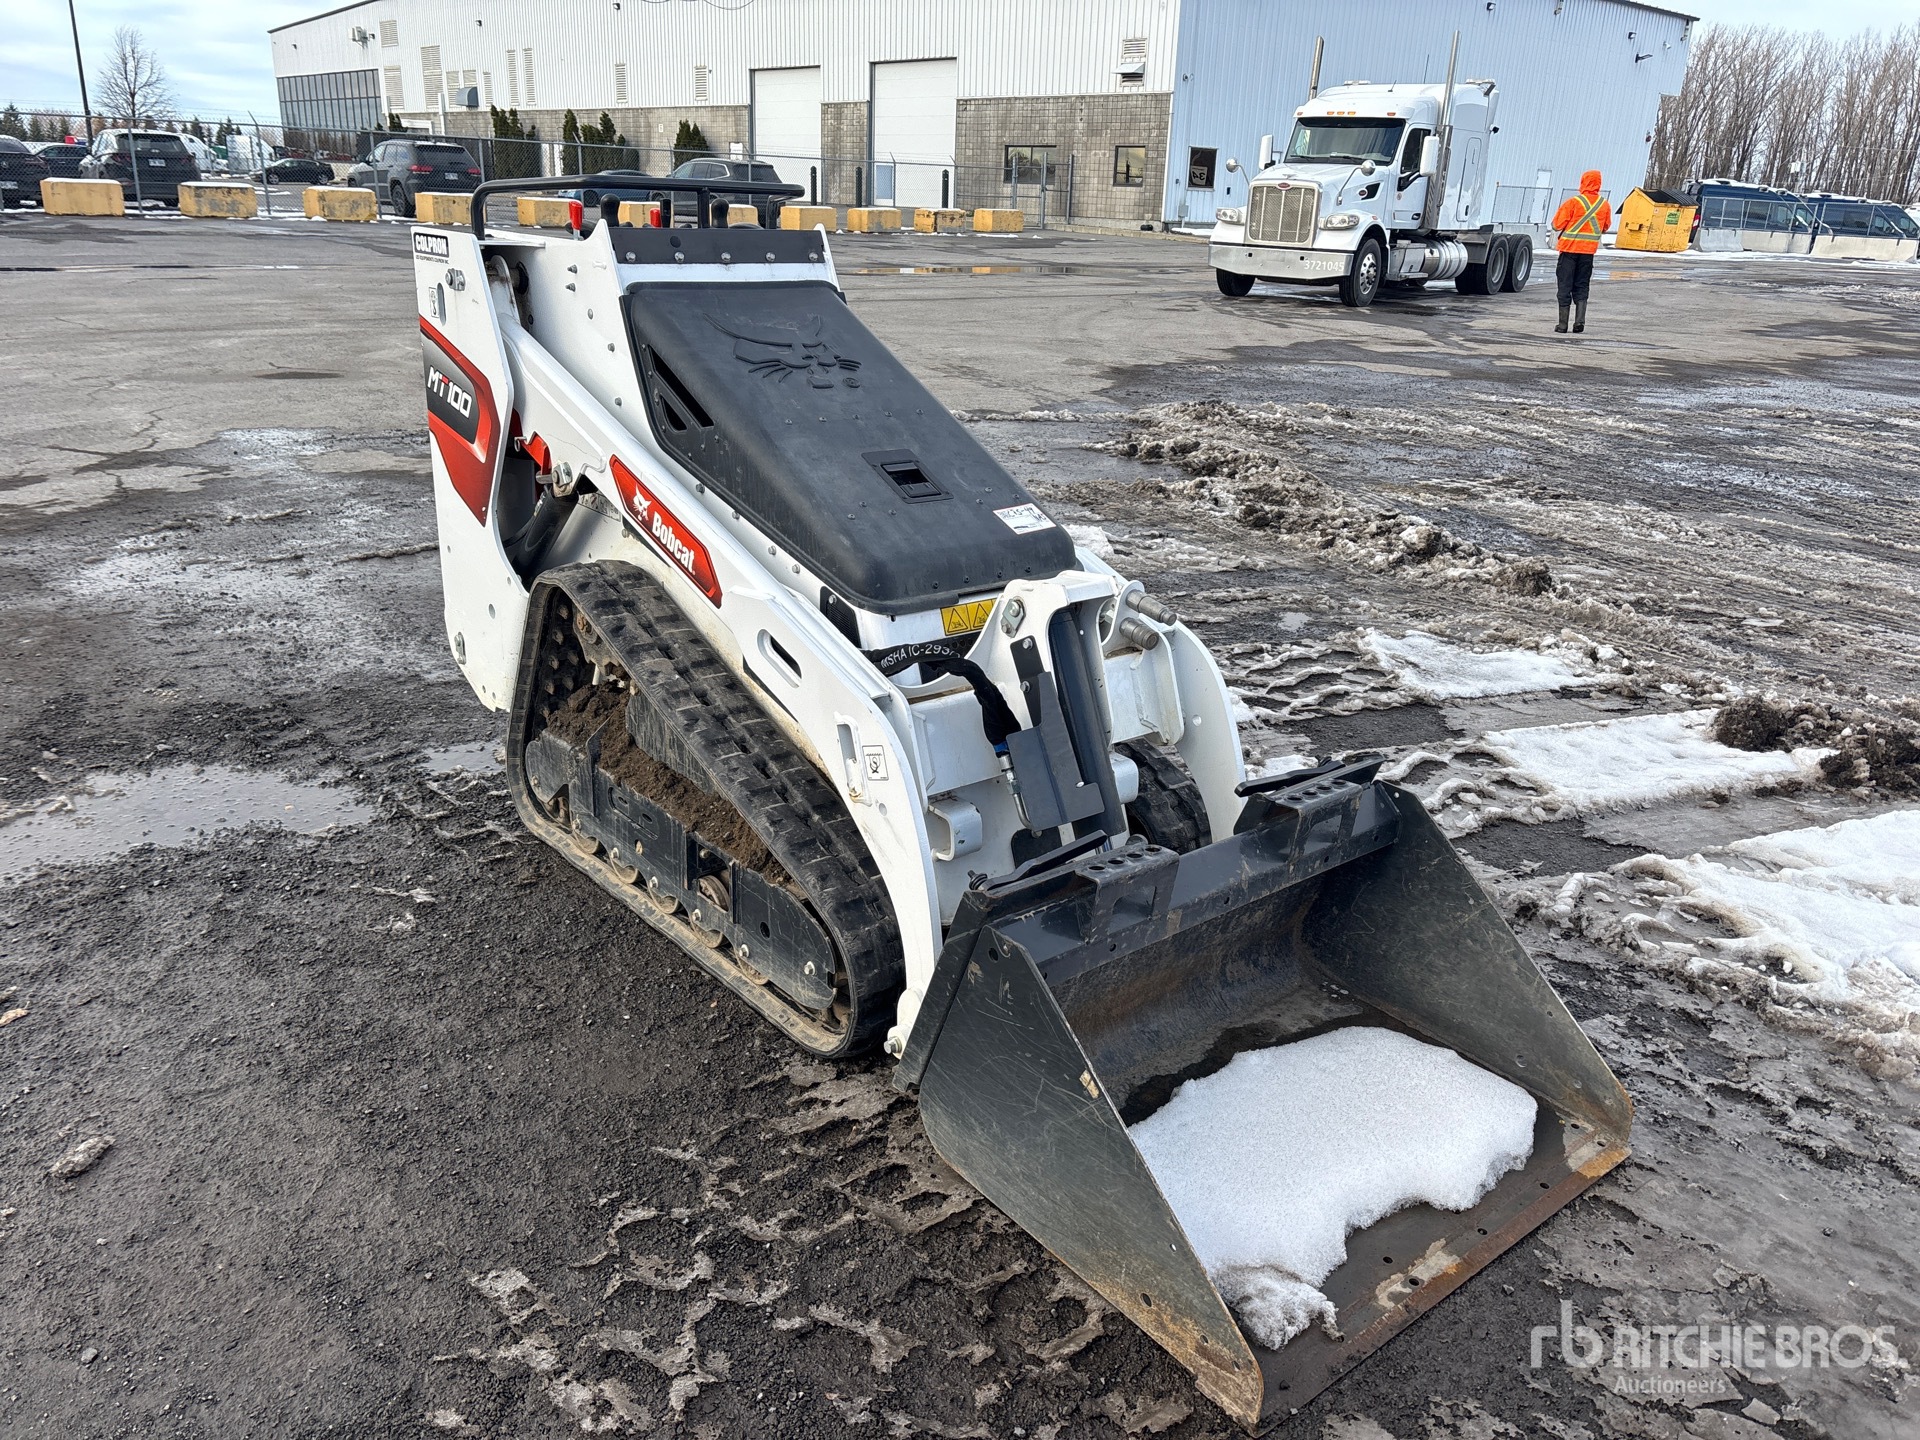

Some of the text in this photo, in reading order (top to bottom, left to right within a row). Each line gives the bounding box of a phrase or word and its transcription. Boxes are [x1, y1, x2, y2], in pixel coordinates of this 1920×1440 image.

[415, 234, 448, 255] COLPRON
[1304, 260, 1345, 271] 3721045
[427, 365, 473, 419] MT100
[651, 511, 694, 573] Bobcat
[880, 648, 907, 669] MSHA
